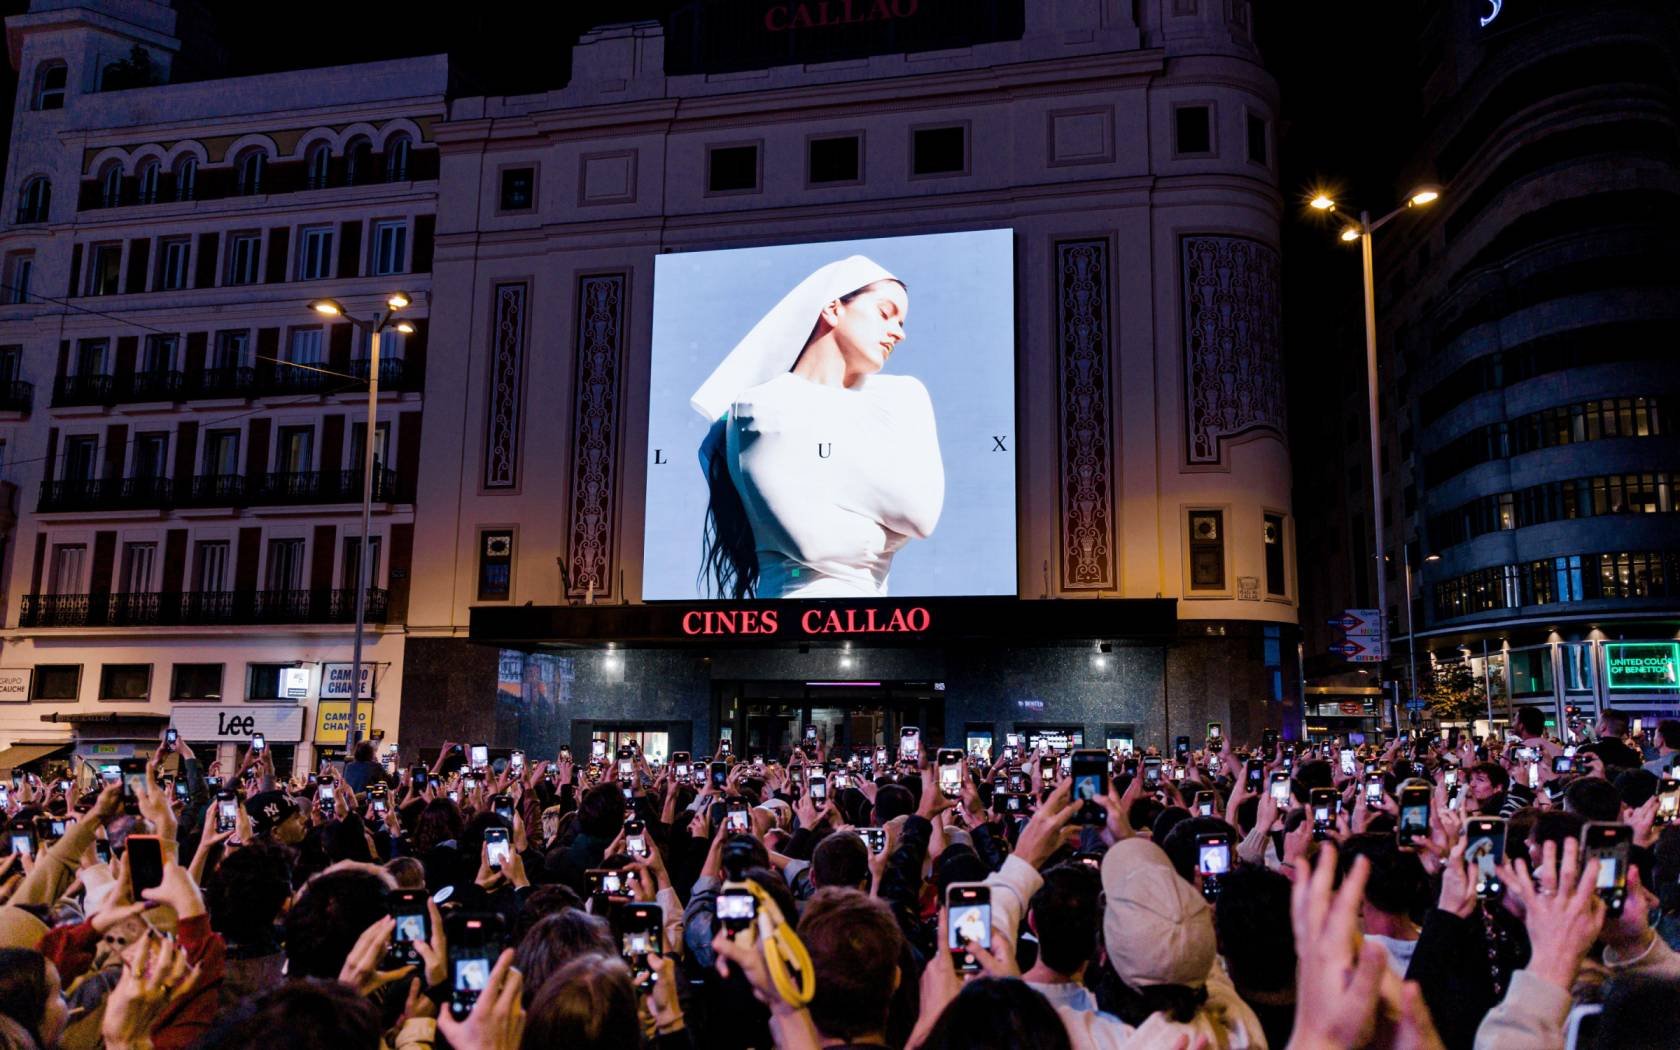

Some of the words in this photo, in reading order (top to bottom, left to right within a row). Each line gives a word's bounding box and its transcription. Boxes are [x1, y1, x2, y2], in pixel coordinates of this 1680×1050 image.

[763, 0, 919, 32] CALLAO
[654, 449, 668, 465] L
[818, 443, 831, 459] U
[991, 435, 1008, 452] X
[682, 610, 779, 635] CINES
[801, 607, 931, 634] CALLAO
[1610, 658, 1643, 666] UNITED
[1644, 657, 1675, 665] COLOR
[330, 669, 369, 680] CAMO
[1611, 666, 1623, 674] OF
[1625, 665, 1670, 674] BENETTON
[328, 682, 366, 693] CHANE
[325, 712, 366, 721] CAMO
[218, 711, 254, 736] Lee
